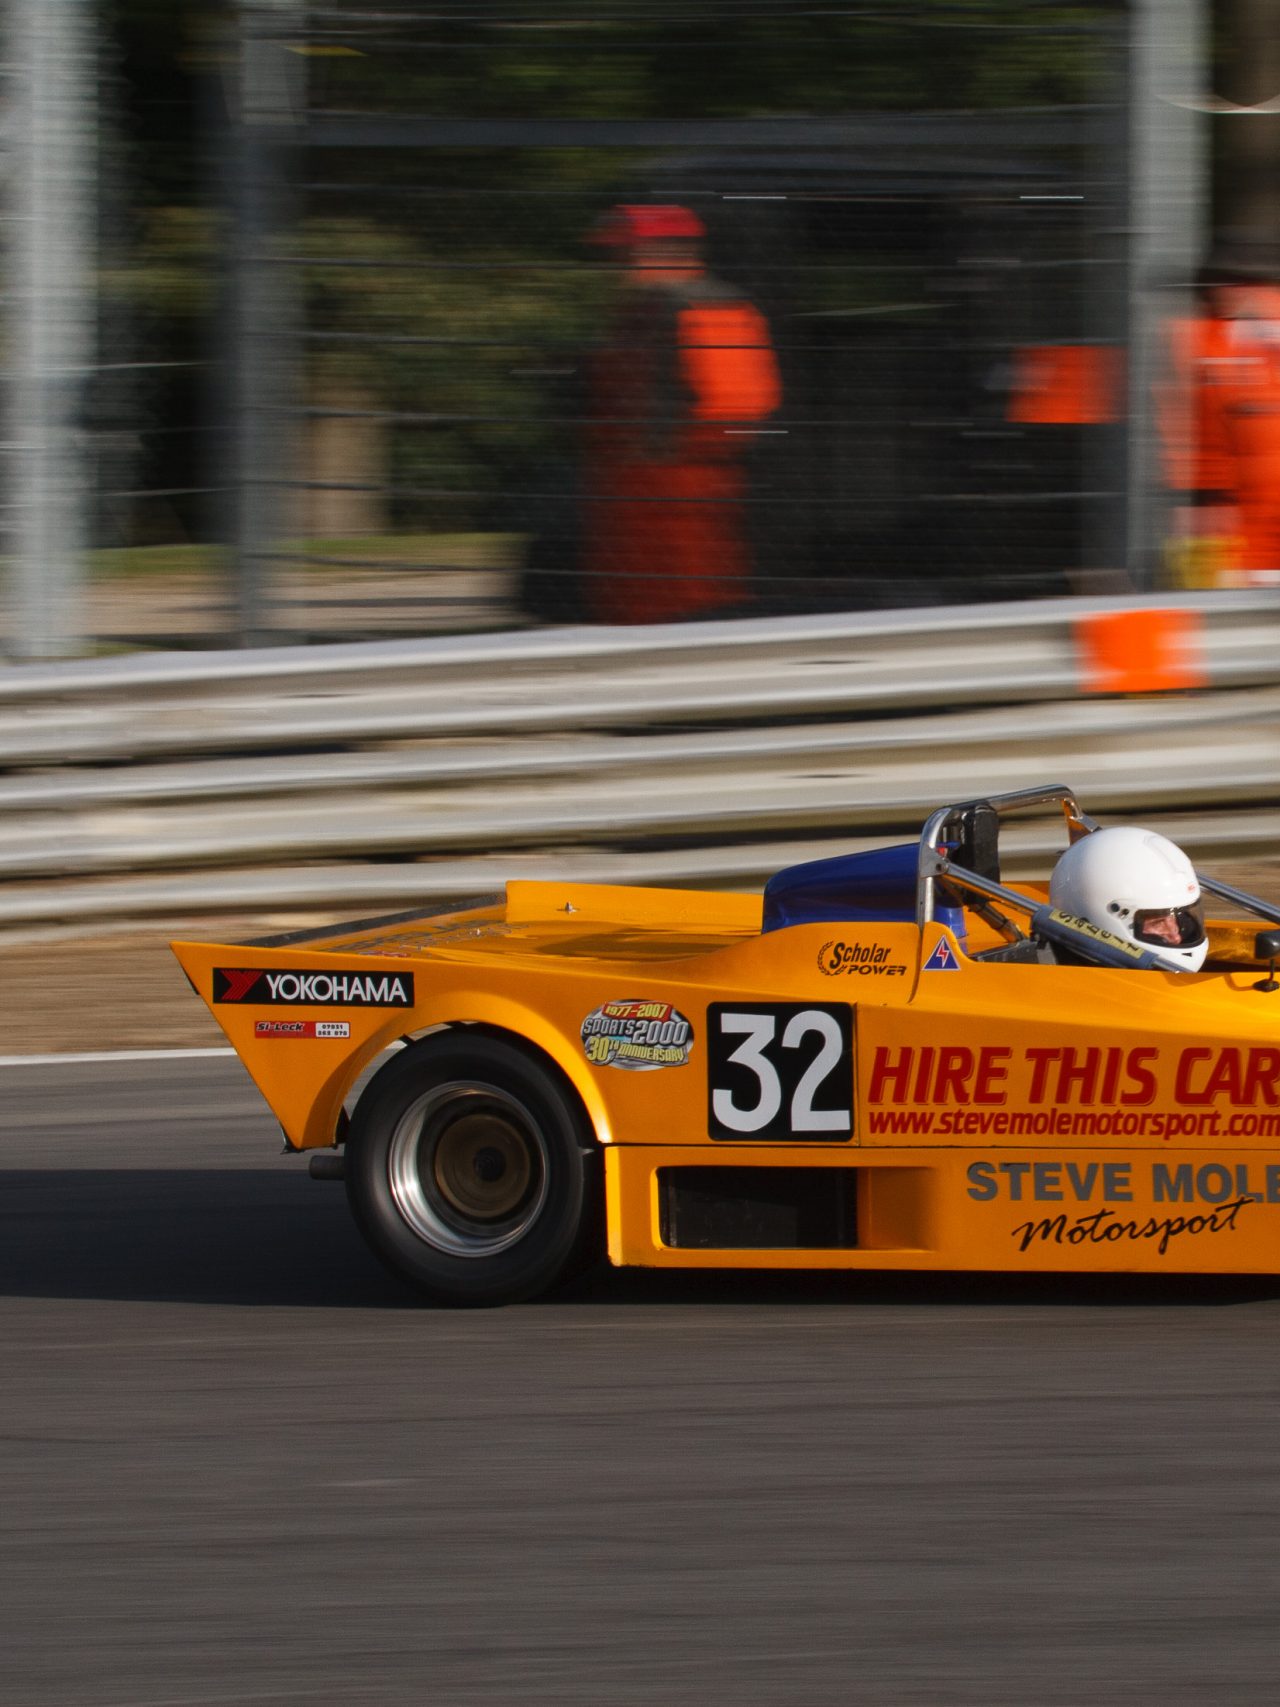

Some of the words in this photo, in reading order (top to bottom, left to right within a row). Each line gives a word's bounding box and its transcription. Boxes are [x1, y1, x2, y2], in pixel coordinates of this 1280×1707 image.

[829, 942, 891, 969] Scholar
[848, 965, 907, 976] POWER
[266, 974, 407, 1002] YOKOHAMA
[604, 1004, 668, 1019] 1977-2007
[617, 1042, 684, 1063] ANNIVERSARY
[711, 1010, 852, 1132] 32
[867, 1046, 1013, 1106] HIRE
[1025, 1047, 1159, 1107] THIS
[966, 1161, 1133, 1201] STEVE
[1011, 1197, 1254, 1255] Motorsport
